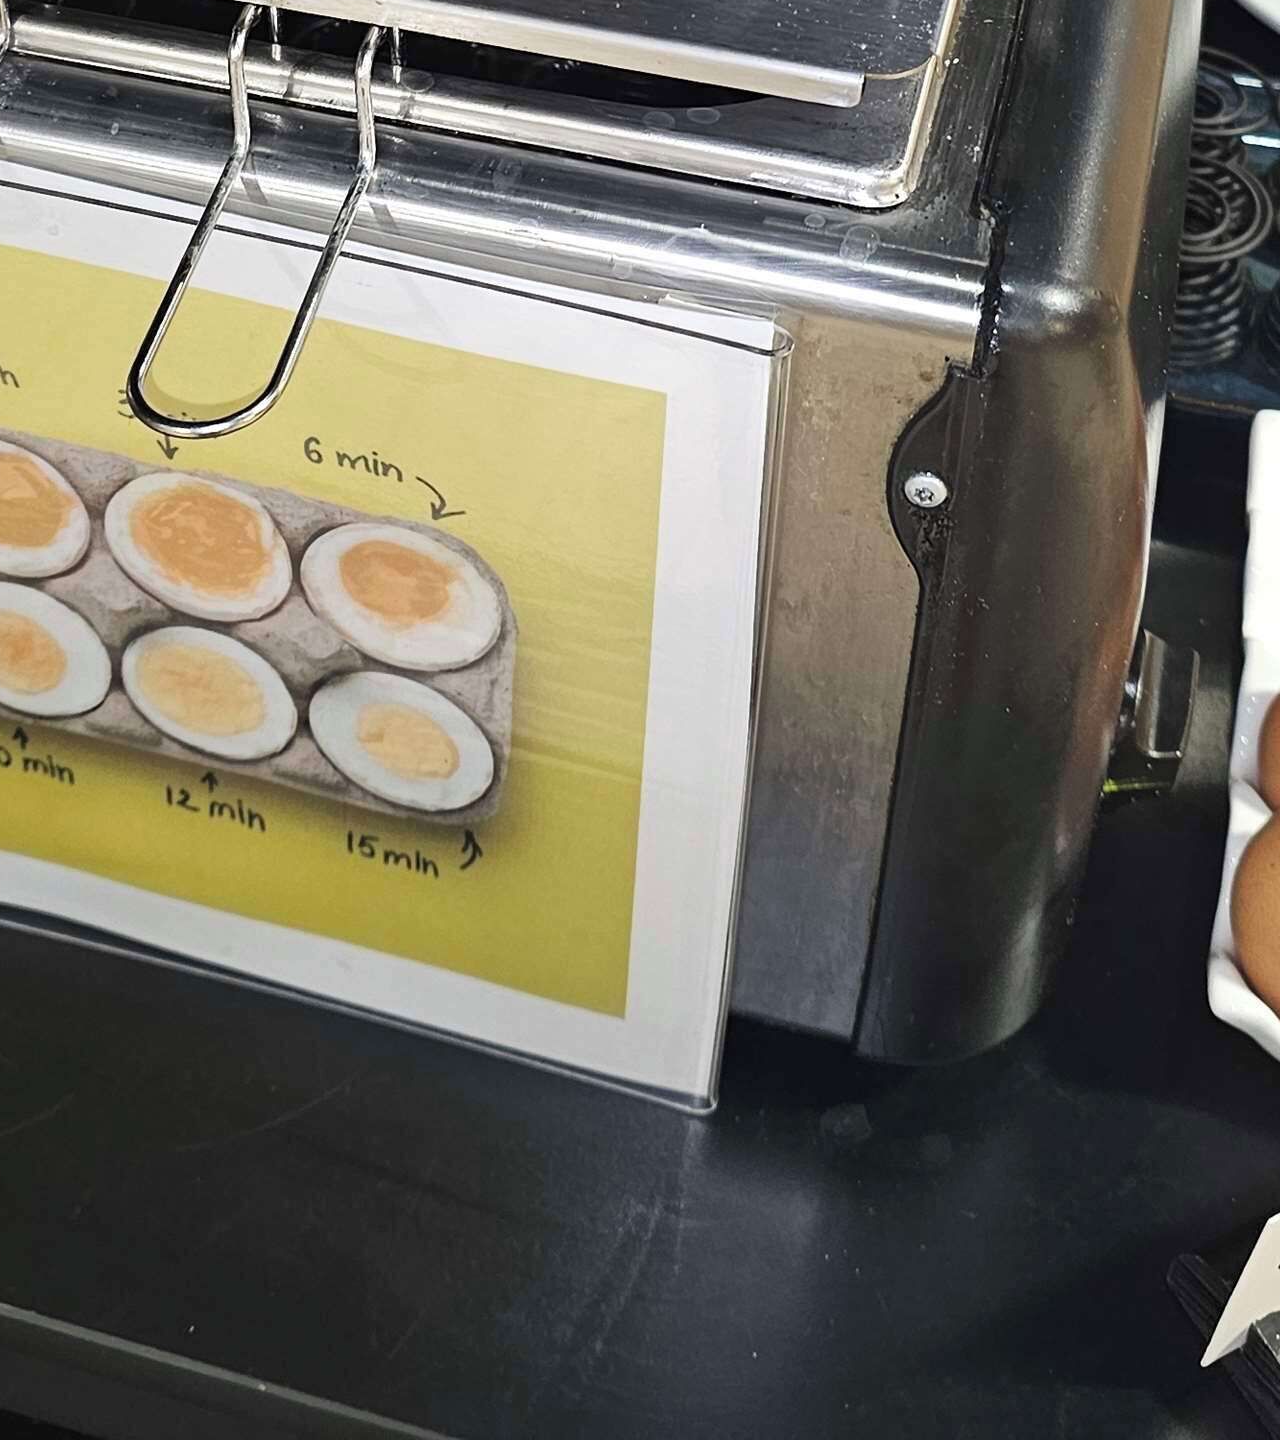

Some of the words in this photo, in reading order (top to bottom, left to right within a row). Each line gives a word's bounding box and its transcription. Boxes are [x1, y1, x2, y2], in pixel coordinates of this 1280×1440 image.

[302, 434, 325, 465] 6
[333, 446, 407, 485] min
[22, 754, 76, 786] min
[165, 785, 200, 814] 12
[209, 798, 268, 834] min
[346, 830, 380, 860] 15
[383, 848, 441, 879] min
